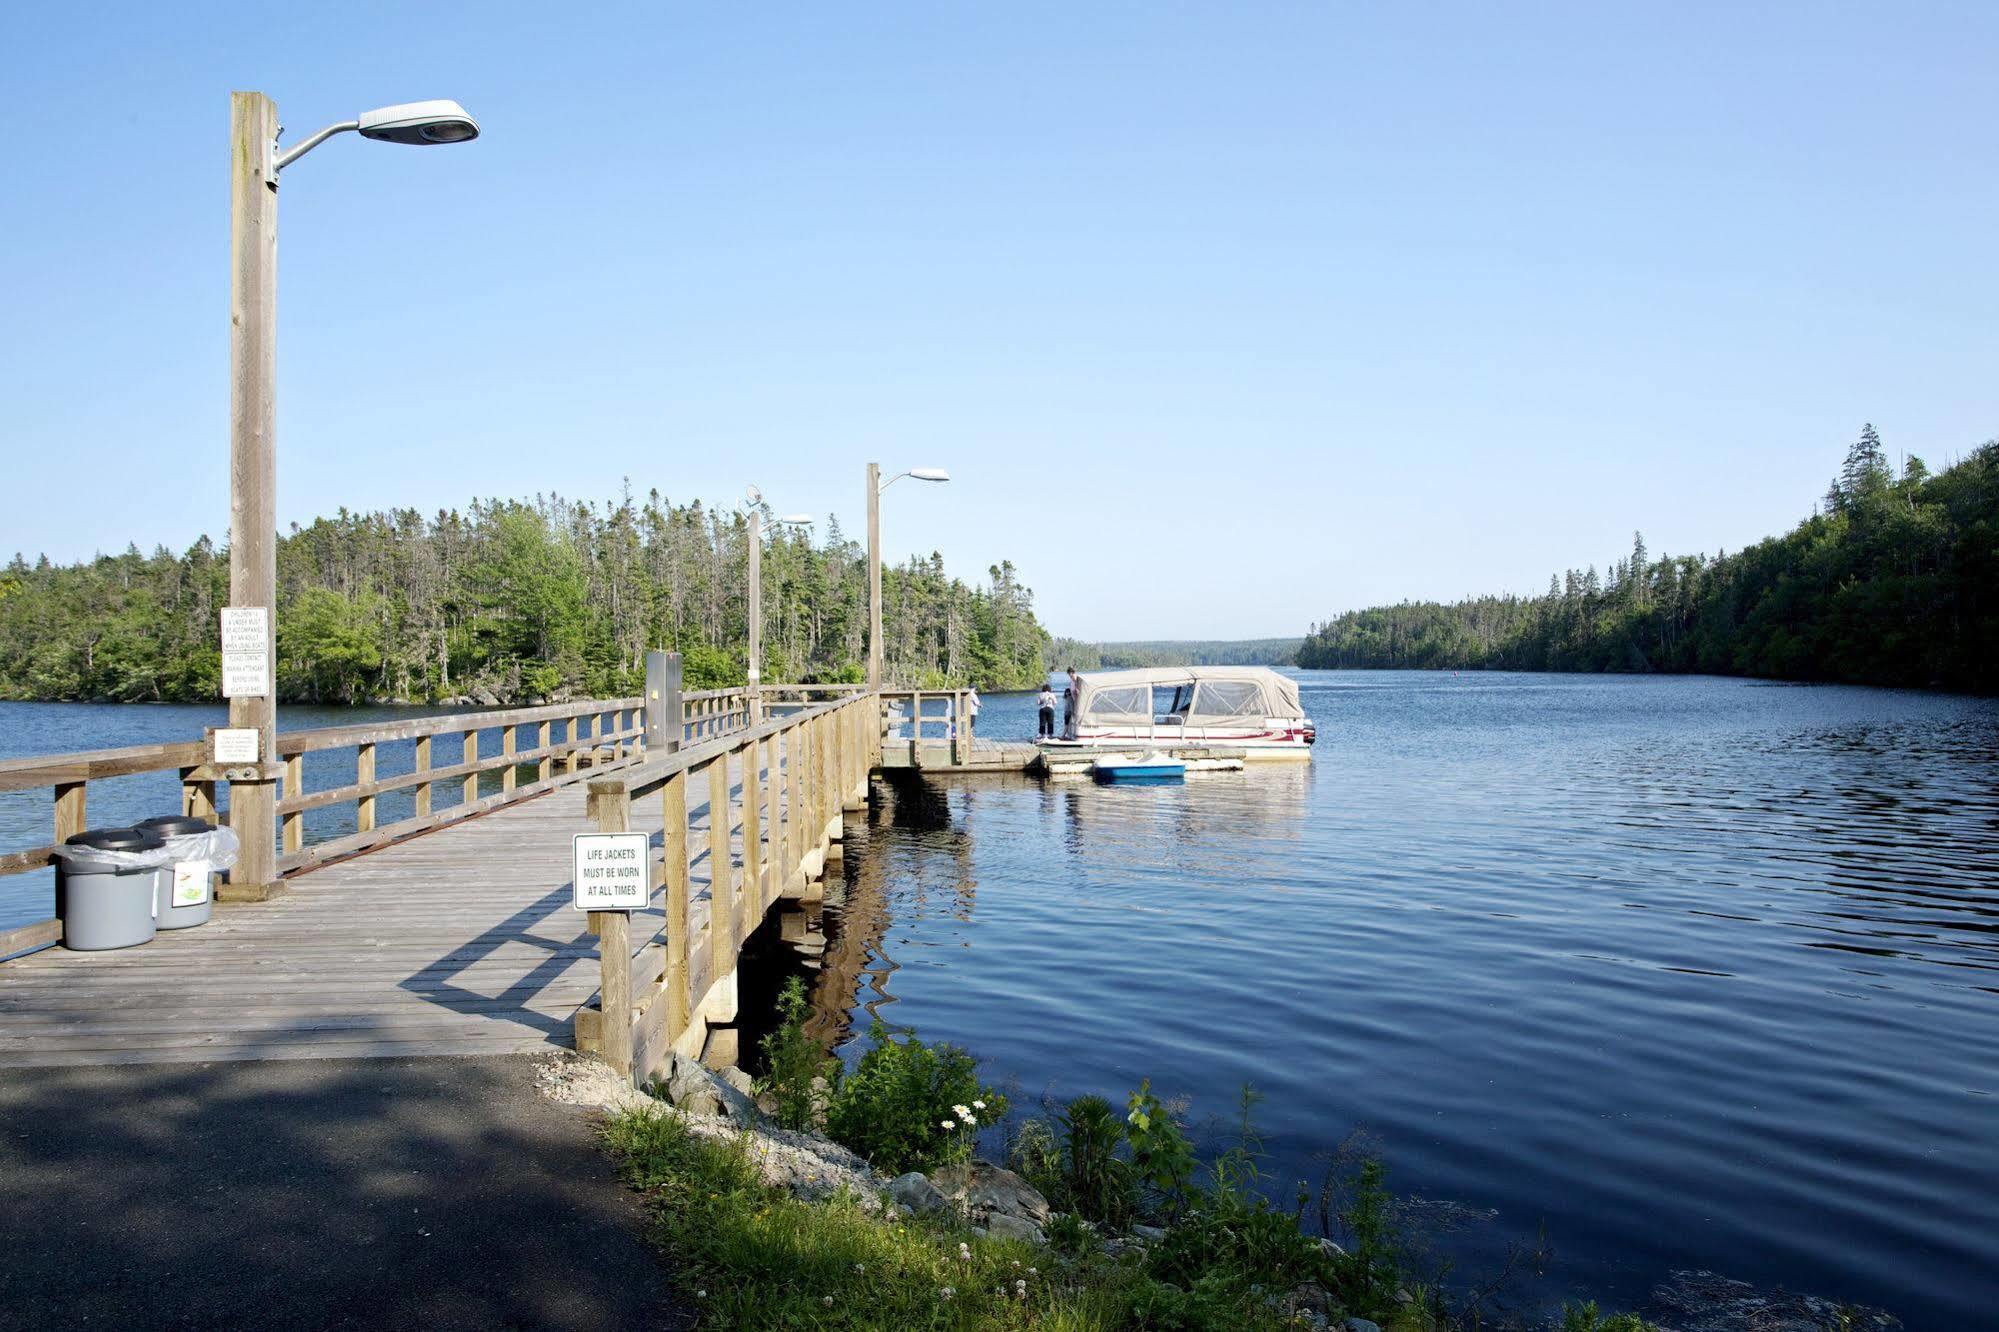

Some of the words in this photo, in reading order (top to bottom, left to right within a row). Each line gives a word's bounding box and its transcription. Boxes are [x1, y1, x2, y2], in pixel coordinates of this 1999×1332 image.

[587, 850, 602, 860] LIFE
[604, 848, 636, 860] JACKETS
[584, 868, 604, 878] MUST
[606, 868, 615, 878] BE
[617, 867, 640, 877] WORN
[588, 886, 596, 896] AT
[599, 886, 612, 896] ALL
[614, 885, 636, 896] TIMES
